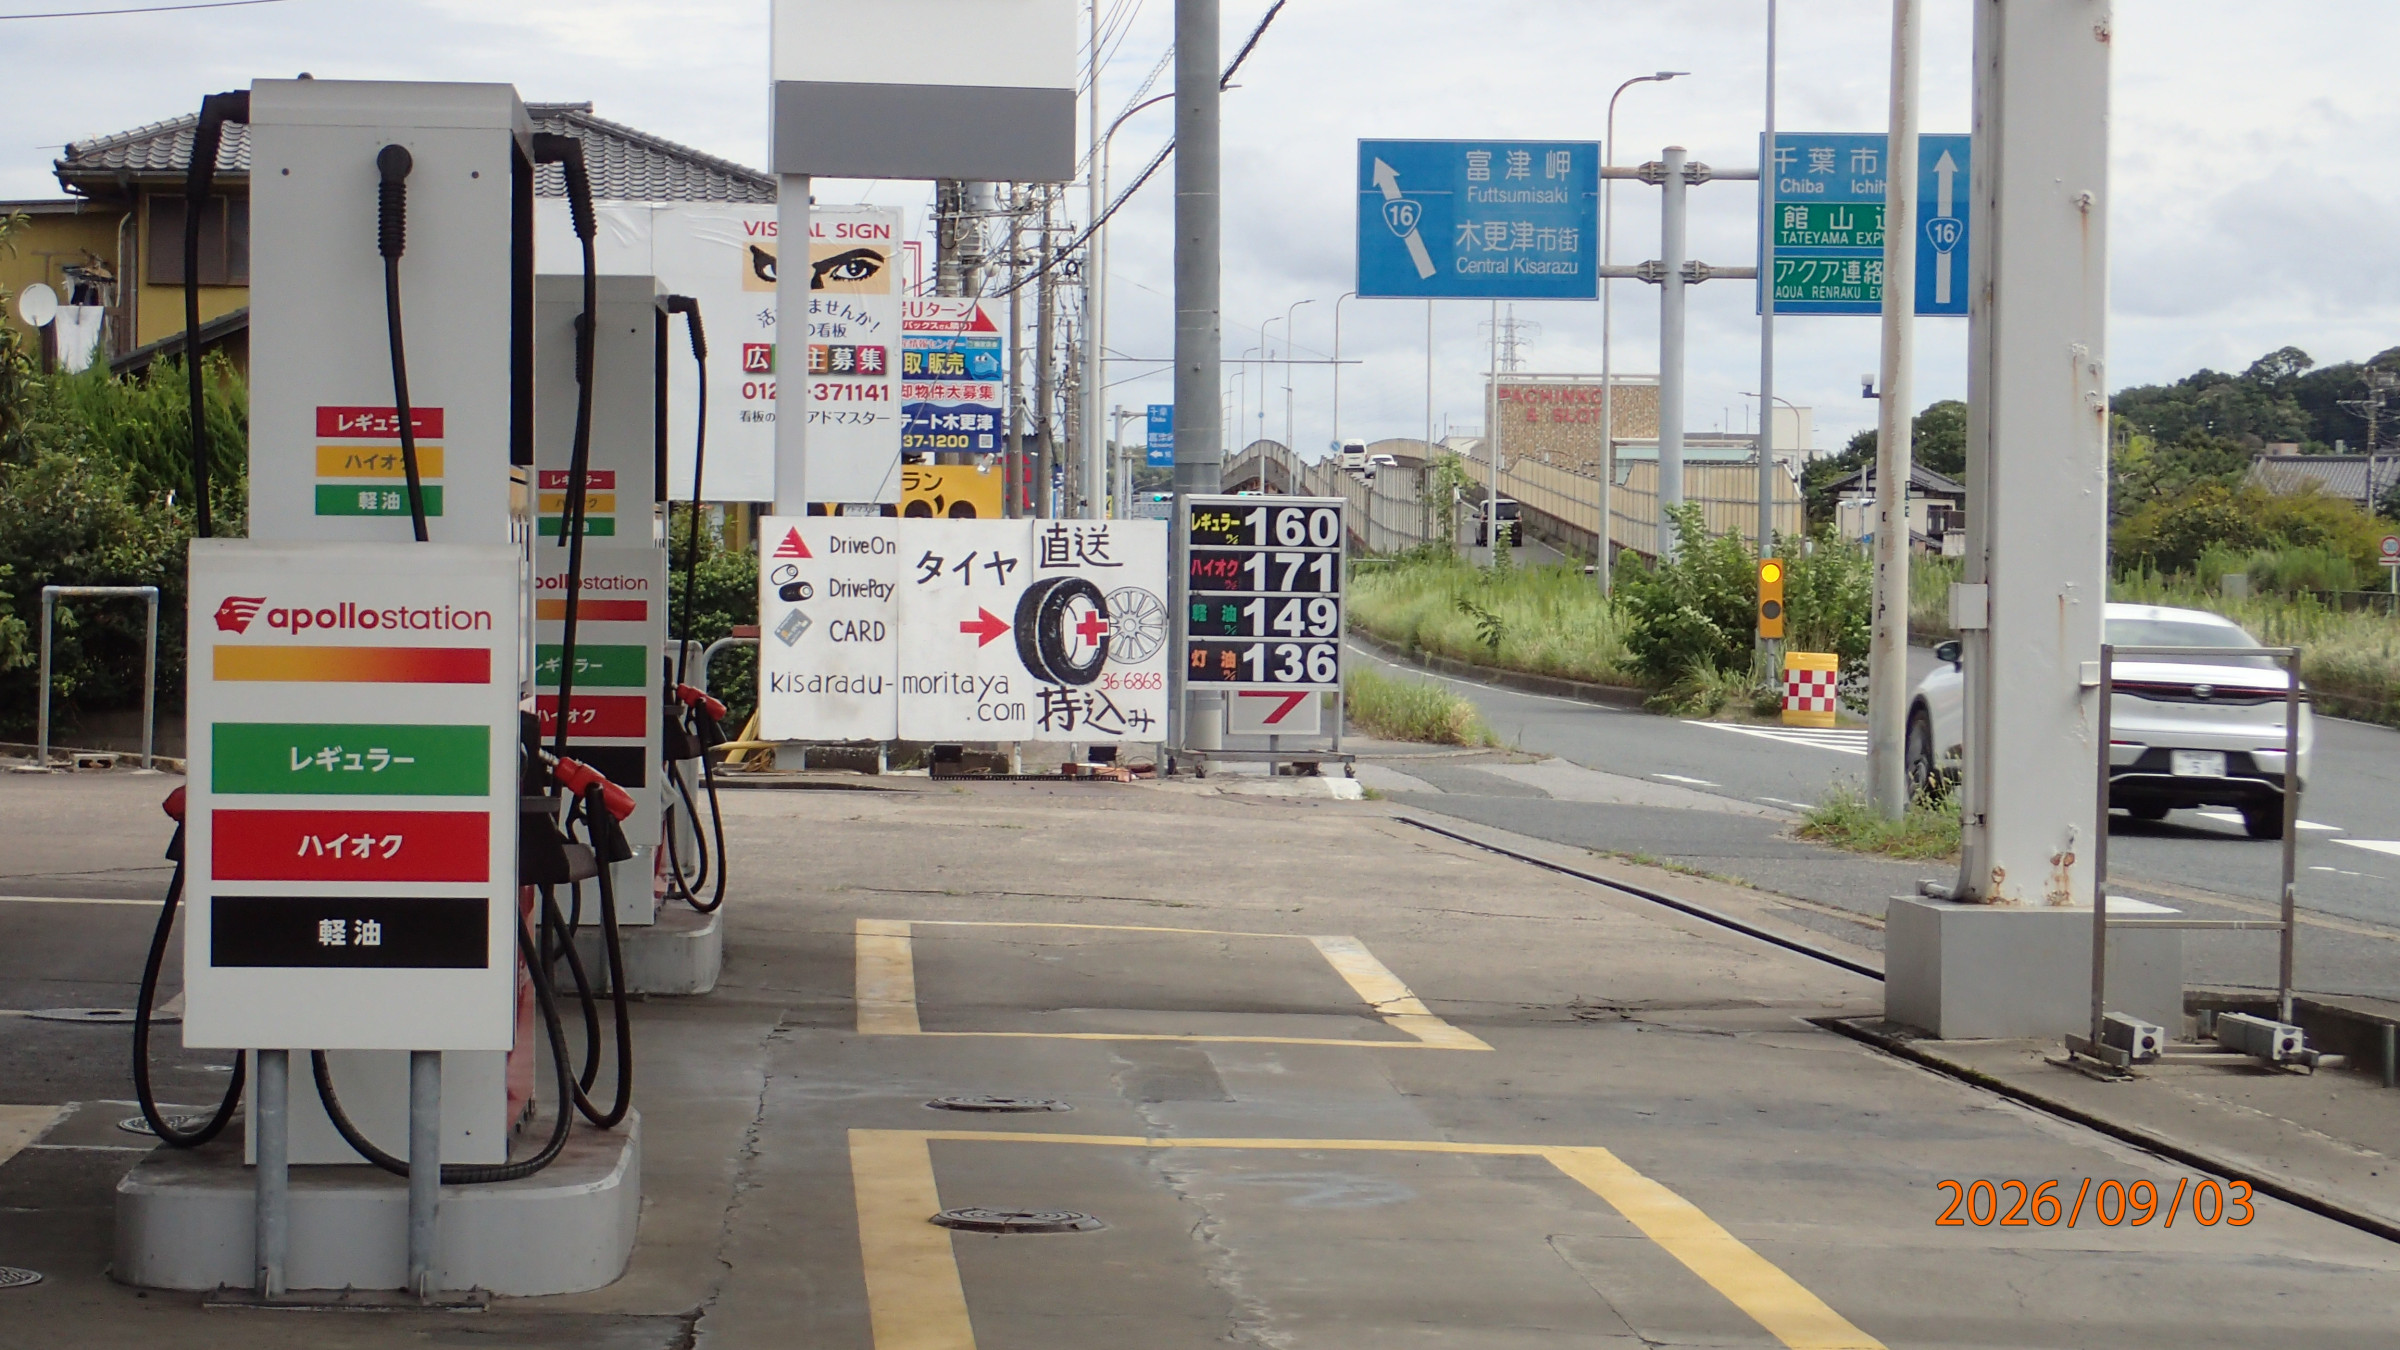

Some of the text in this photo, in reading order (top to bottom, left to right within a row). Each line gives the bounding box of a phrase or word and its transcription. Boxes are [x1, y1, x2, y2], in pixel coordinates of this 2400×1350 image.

[1465, 150, 1571, 182] 富津岬
[1467, 187, 1568, 203] Futtsumisaki
[1780, 178, 1824, 194] Chiba
[1389, 205, 1414, 226] 16
[743, 220, 890, 239] VISL SIGN
[1456, 220, 1579, 252] 木更津市街
[1781, 232, 1849, 245] TATEYAMA
[1934, 223, 1955, 244] 16
[1456, 258, 1578, 275] Central Kisarazu
[1775, 285, 1804, 299] AQUA
[1812, 286, 1861, 300] RENRAKU
[745, 345, 883, 372] 広主募集
[1552, 407, 1602, 423] SLOT
[903, 434, 970, 448] 37-1200
[358, 491, 401, 510] 軽油
[1191, 506, 1339, 547] レギュラー 160
[830, 535, 897, 555] DriveOn
[1040, 522, 1123, 568] 直送
[916, 550, 1018, 587] タイヤ
[1191, 551, 1333, 592] ハイオク 171
[829, 577, 896, 603] DrivePay
[267, 601, 492, 635] apollostation
[1243, 597, 1338, 637] 149
[829, 619, 886, 642] CARD
[1242, 642, 1338, 682] 136
[1100, 671, 1162, 691] 36-6868
[966, 702, 1026, 722] .com
[1036, 686, 1156, 734] 持込み
[289, 745, 416, 773] レギュラー
[297, 833, 404, 860] ハイオク
[318, 918, 382, 947] 軽油
